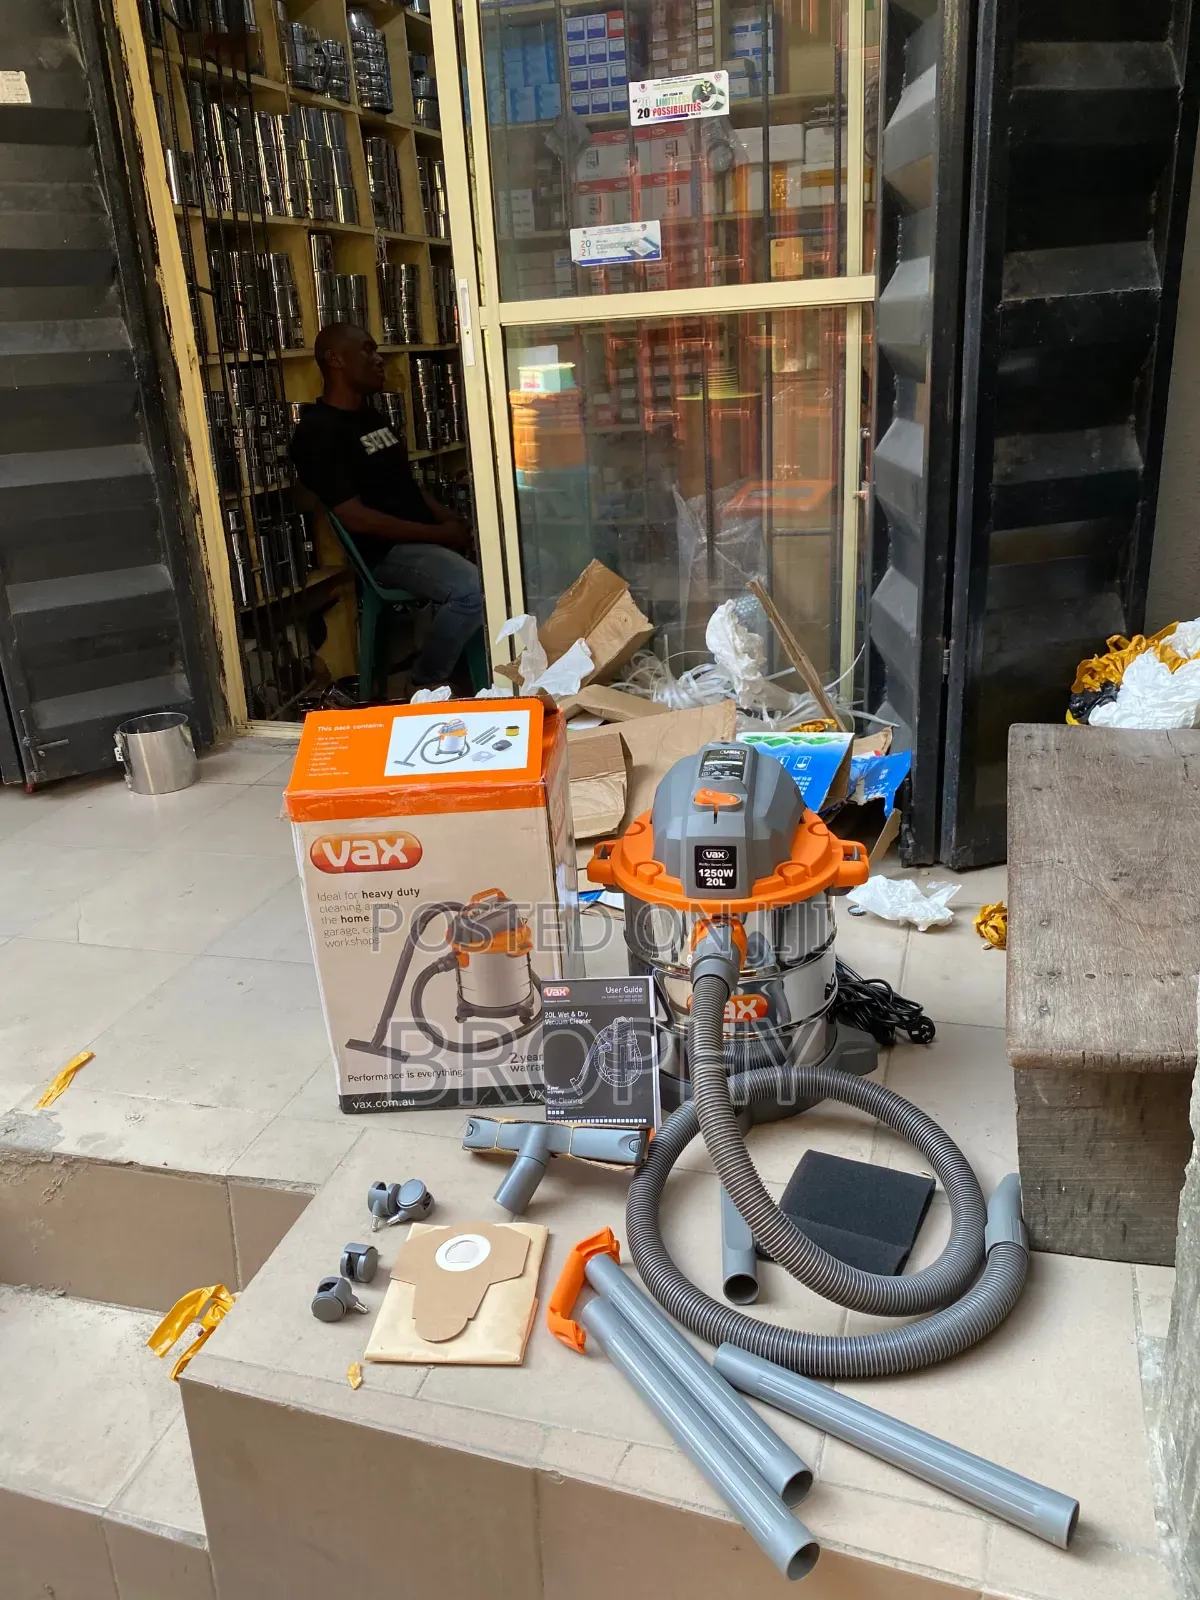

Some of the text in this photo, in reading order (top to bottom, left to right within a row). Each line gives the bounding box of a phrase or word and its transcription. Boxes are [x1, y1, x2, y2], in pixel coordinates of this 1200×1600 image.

[637, 108, 650, 119] 20
[652, 103, 702, 117] POSSIBILITIES
[321, 838, 409, 868] vax
[705, 851, 725, 859] vax
[698, 869, 734, 878] 1250W
[706, 878, 726, 886] 20L
[317, 887, 420, 901] Ideal for heavy duty
[320, 902, 361, 914] cleaning
[321, 915, 338, 925] the
[545, 988, 567, 996] vax
[605, 985, 643, 994] User Guide
[557, 1010, 570, 1018] Wet
[577, 1010, 589, 1018] Dry
[724, 1000, 758, 1019] ax
[569, 1017, 592, 1025] Cleaner
[510, 1052, 519, 1063] 2
[347, 1068, 466, 1082] Performance is everything.
[352, 1098, 416, 1109] vax.com.au
